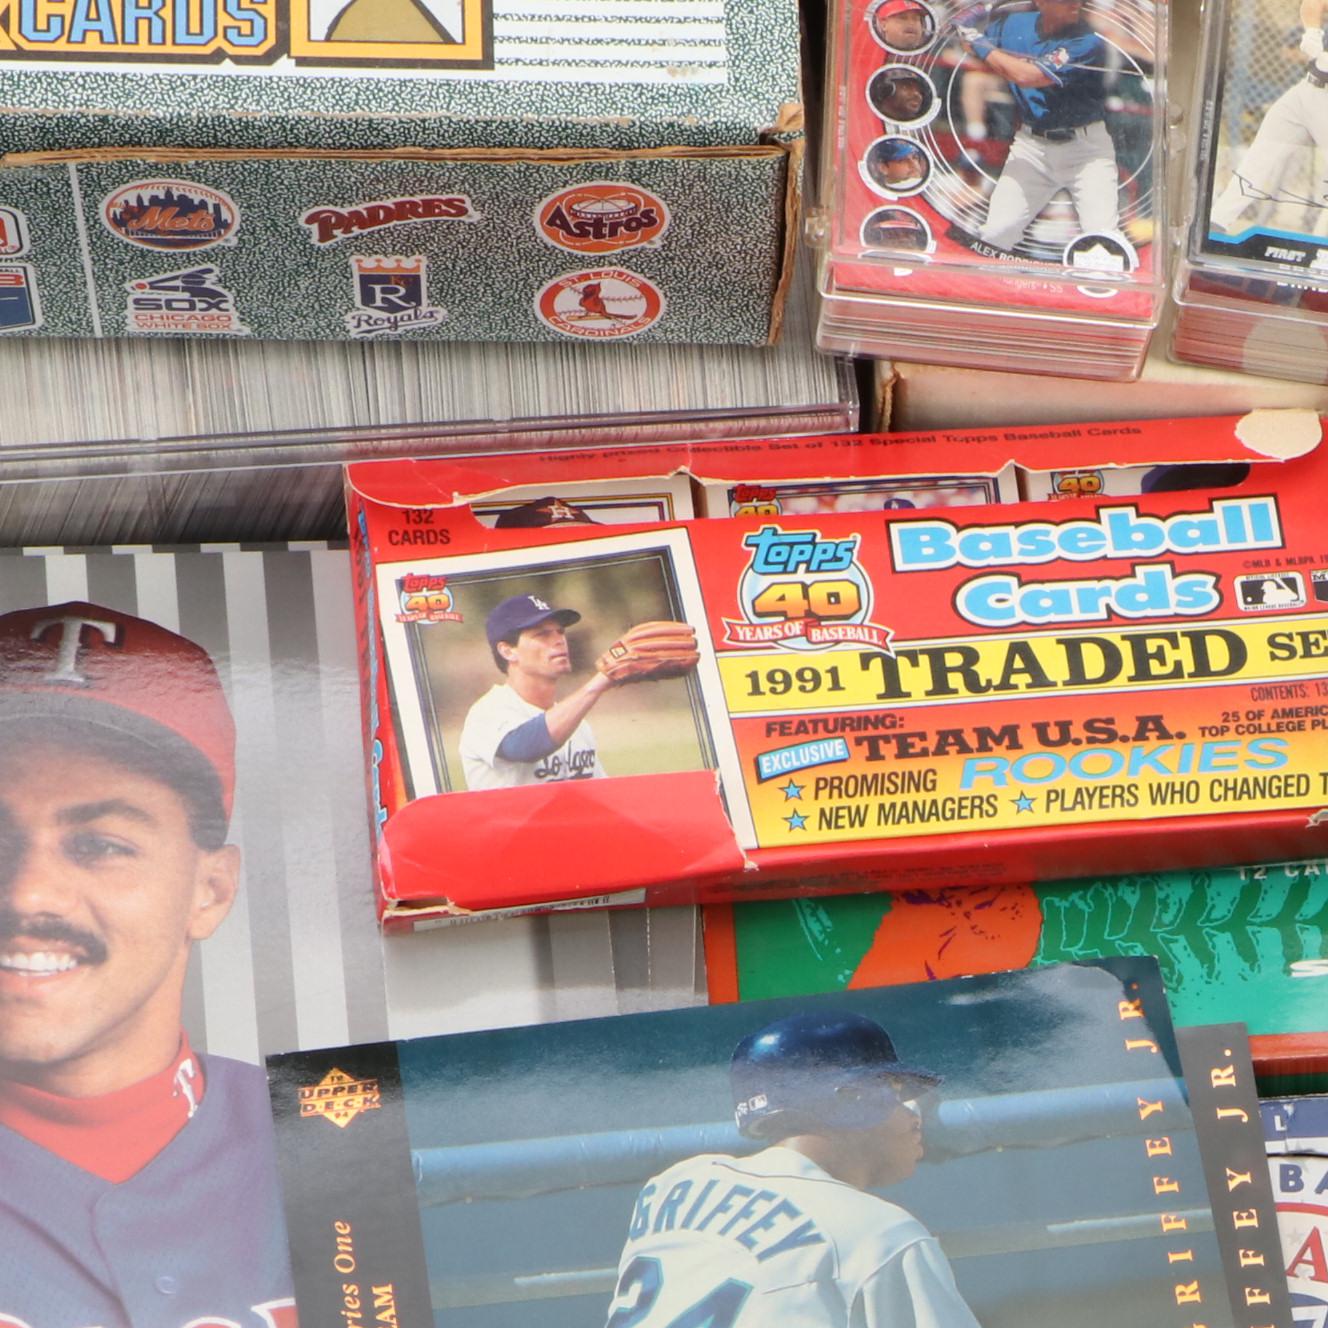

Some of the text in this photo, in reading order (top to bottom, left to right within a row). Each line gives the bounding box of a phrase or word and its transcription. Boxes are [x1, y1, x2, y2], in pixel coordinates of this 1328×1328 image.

[127, 206, 216, 231] Mets
[305, 198, 469, 243] PADRES
[546, 205, 657, 239] Astros
[589, 269, 643, 288] LOUIS
[133, 297, 229, 312] SOX
[134, 313, 232, 322] CHICAGO
[137, 322, 185, 330] WHITE
[352, 306, 437, 335] Royals
[549, 315, 651, 338] CARDINALS
[403, 509, 434, 524] 132
[388, 530, 450, 545] CARDS
[893, 498, 1280, 568] Baseball
[752, 580, 862, 621] 40
[958, 563, 1221, 622] Cards
[736, 624, 882, 645] YEARS OF BASEBALL
[746, 666, 845, 696] 1991
[861, 628, 1247, 699] TRADED
[1251, 683, 1310, 702] CONTENTS:
[765, 713, 904, 738] FEATURING:
[1222, 711, 1240, 722] 25
[1245, 710, 1264, 721] OF
[1199, 725, 1229, 738] TOP
[1235, 721, 1306, 735] COLLEGE
[762, 714, 1186, 774] EXCLUSIVE TEAM U.S.A.
[814, 738, 1289, 800] PROMISING ROOKIES
[819, 804, 868, 831] NEW
[877, 794, 998, 825] MANAGERS
[1046, 784, 1139, 813] PLAYERS
[1149, 780, 1200, 806] WHO
[1209, 774, 1310, 802] CHANGED
[300, 1083, 377, 1101] UPPER
[629, 1179, 825, 1263] GRIFFEY
[334, 1219, 356, 1274] One
